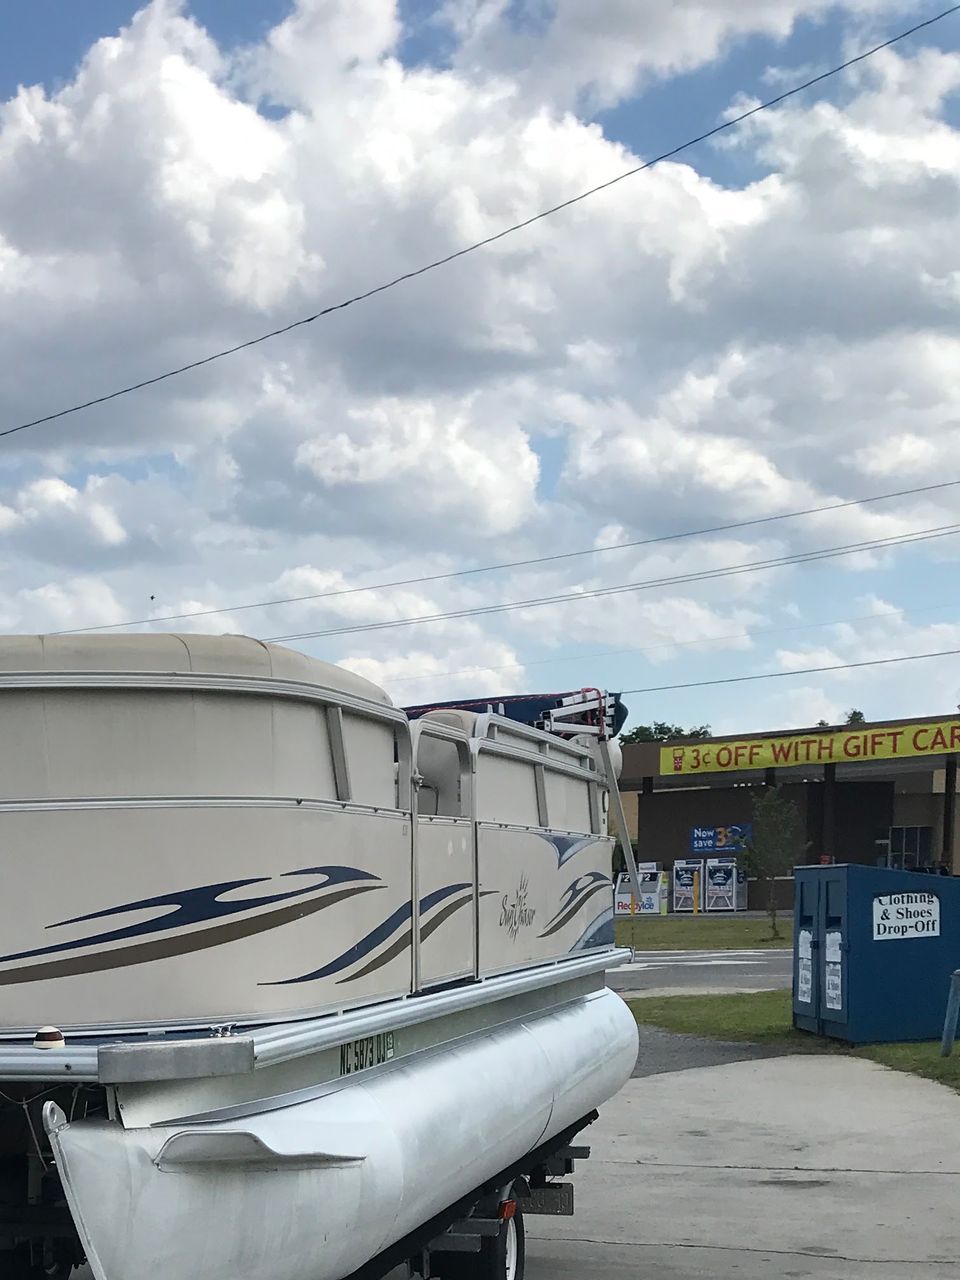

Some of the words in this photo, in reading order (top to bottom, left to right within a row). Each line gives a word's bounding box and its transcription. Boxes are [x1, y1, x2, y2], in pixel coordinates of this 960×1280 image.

[690, 748, 711, 769] 3¢
[716, 744, 762, 767] OFF
[771, 738, 833, 763] WITH
[843, 731, 904, 757] GIFT
[912, 725, 960, 751] CAR
[694, 828, 715, 838] Now
[693, 840, 713, 848] save
[878, 894, 934, 906] Clothing
[880, 908, 891, 921] &
[896, 906, 933, 920] Shoes
[876, 919, 937, 936] Drop-Off
[339, 1042, 352, 1076] NC
[354, 1036, 374, 1072] 5873
